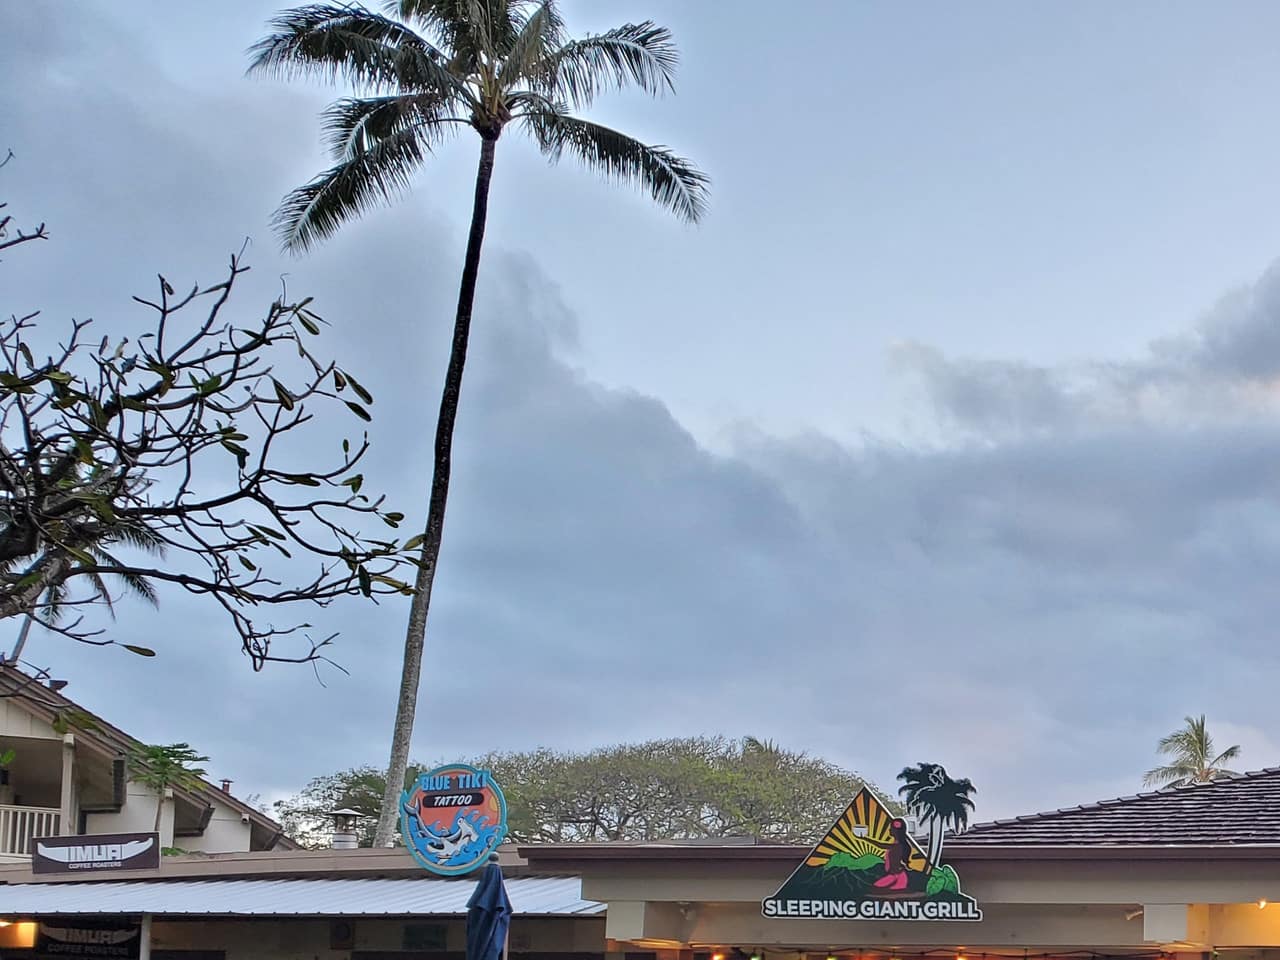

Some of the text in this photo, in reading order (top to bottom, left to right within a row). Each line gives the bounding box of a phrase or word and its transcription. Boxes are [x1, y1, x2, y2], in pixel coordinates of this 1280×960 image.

[421, 773, 488, 791] BLUE TIKI
[433, 795, 472, 807] TATTOO
[68, 861, 121, 870] COFFEE ROASTERS
[764, 900, 979, 918] SLEEPING GIANT GRILL
